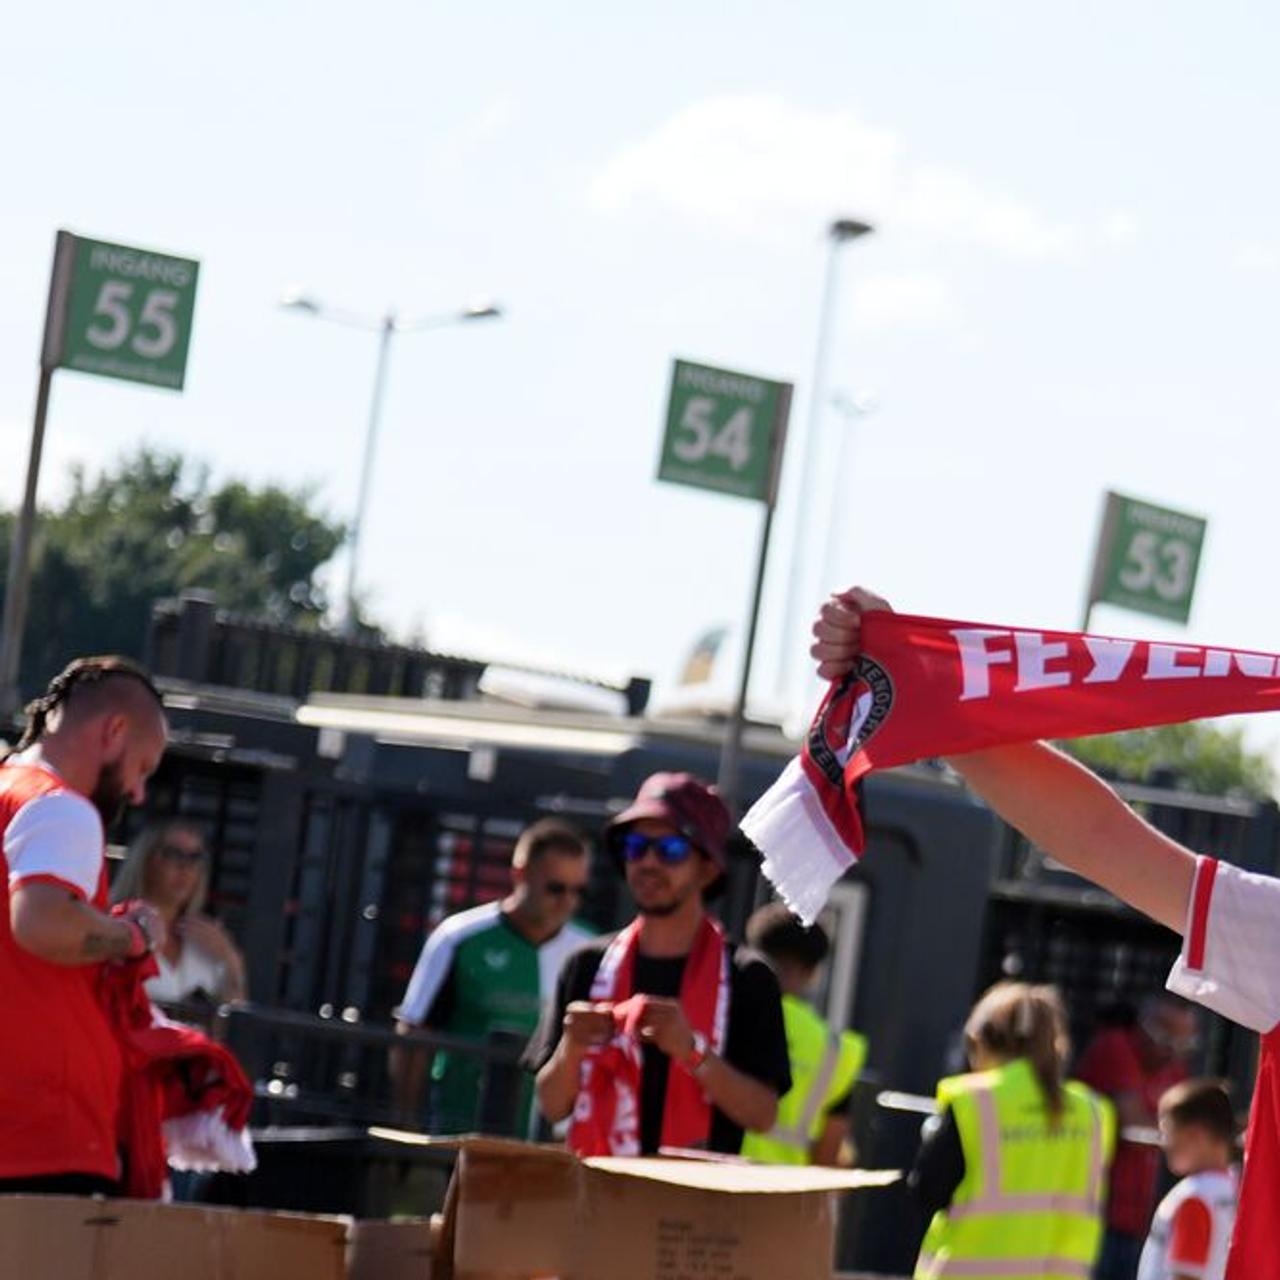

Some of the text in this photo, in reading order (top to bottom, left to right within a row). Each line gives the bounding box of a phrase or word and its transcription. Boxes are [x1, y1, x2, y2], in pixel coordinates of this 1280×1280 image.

[86, 280, 178, 359] 55
[673, 396, 754, 471] 54
[1119, 531, 1191, 600] 53
